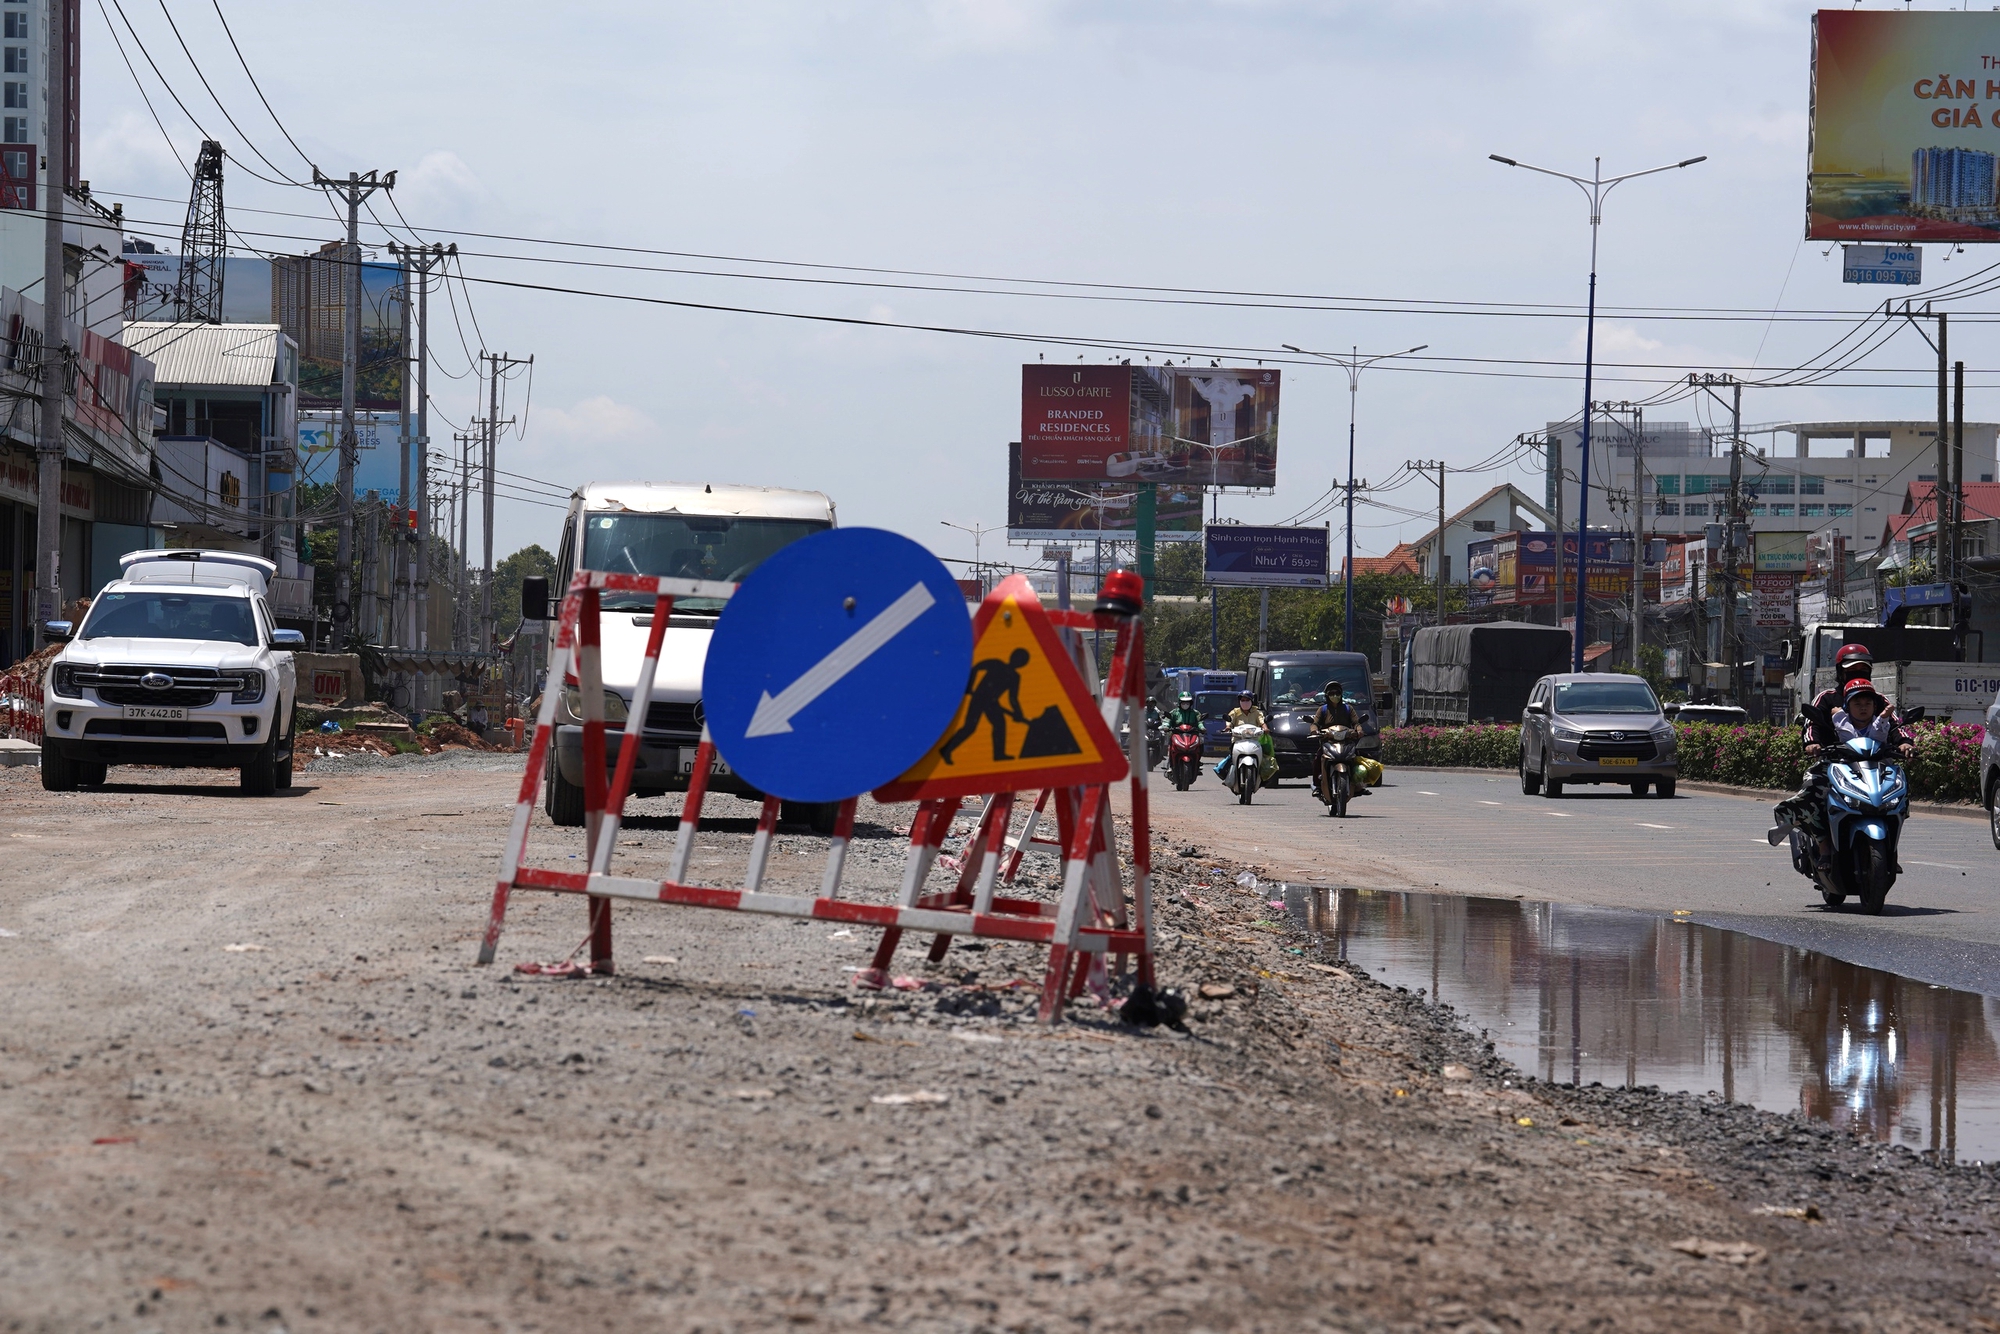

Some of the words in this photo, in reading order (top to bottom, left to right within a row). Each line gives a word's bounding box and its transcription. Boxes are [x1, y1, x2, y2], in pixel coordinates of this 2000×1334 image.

[1914, 74, 1975, 99] CĂN
[1931, 103, 1982, 128] GIÁ
[1838, 222, 1917, 232] www.thewincity.vn
[1845, 269, 1872, 281] 0916
[1875, 270, 1896, 282] 095
[1900, 271, 1920, 282] 795
[1040, 387, 1075, 397] LUSSO
[1047, 410, 1104, 420] BRANDED
[1040, 423, 1111, 433] RESIDENCES
[1211, 533, 1232, 541] Sinh
[1253, 535, 1272, 543] trọn
[1274, 535, 1298, 544] Hạnh
[1300, 536, 1323, 544] Phúc
[1255, 555, 1278, 565] Như
[1279, 553, 1287, 566] Ý
[1291, 558, 1310, 567] 59,9
[129, 708, 182, 719] 37K-442.06
